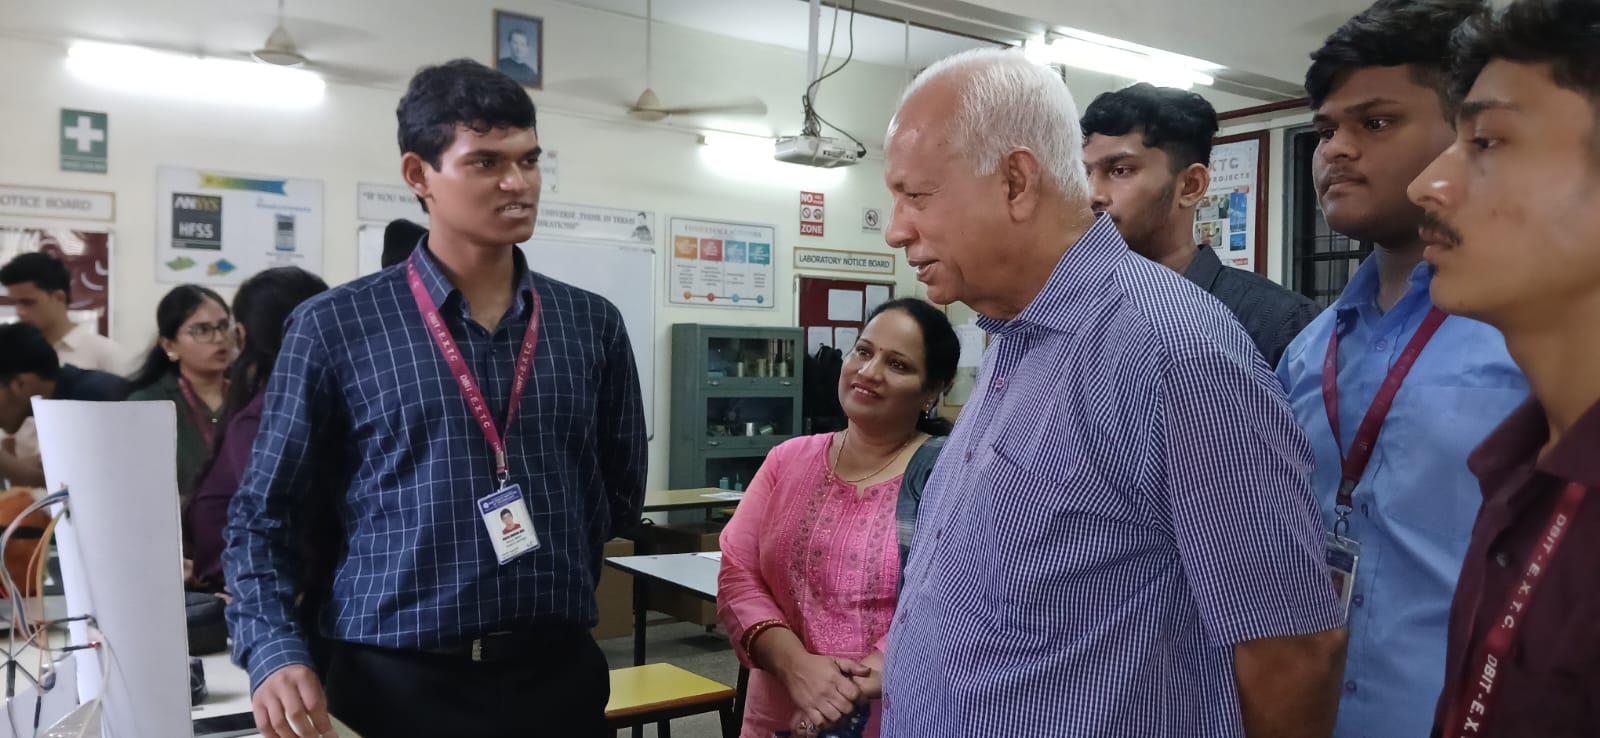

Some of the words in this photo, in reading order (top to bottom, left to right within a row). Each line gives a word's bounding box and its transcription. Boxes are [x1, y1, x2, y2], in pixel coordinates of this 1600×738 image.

[1209, 157, 1239, 171] XTC
[1210, 171, 1250, 183] ROJECTS
[0, 194, 40, 208] OTICE
[45, 197, 92, 210] BOARD
[801, 193, 813, 203] NO
[178, 221, 214, 239] HFSS
[801, 224, 822, 234] ZONE
[799, 254, 841, 266] LABORATORY
[842, 257, 866, 267] NOTICE
[868, 259, 890, 268] BOARD
